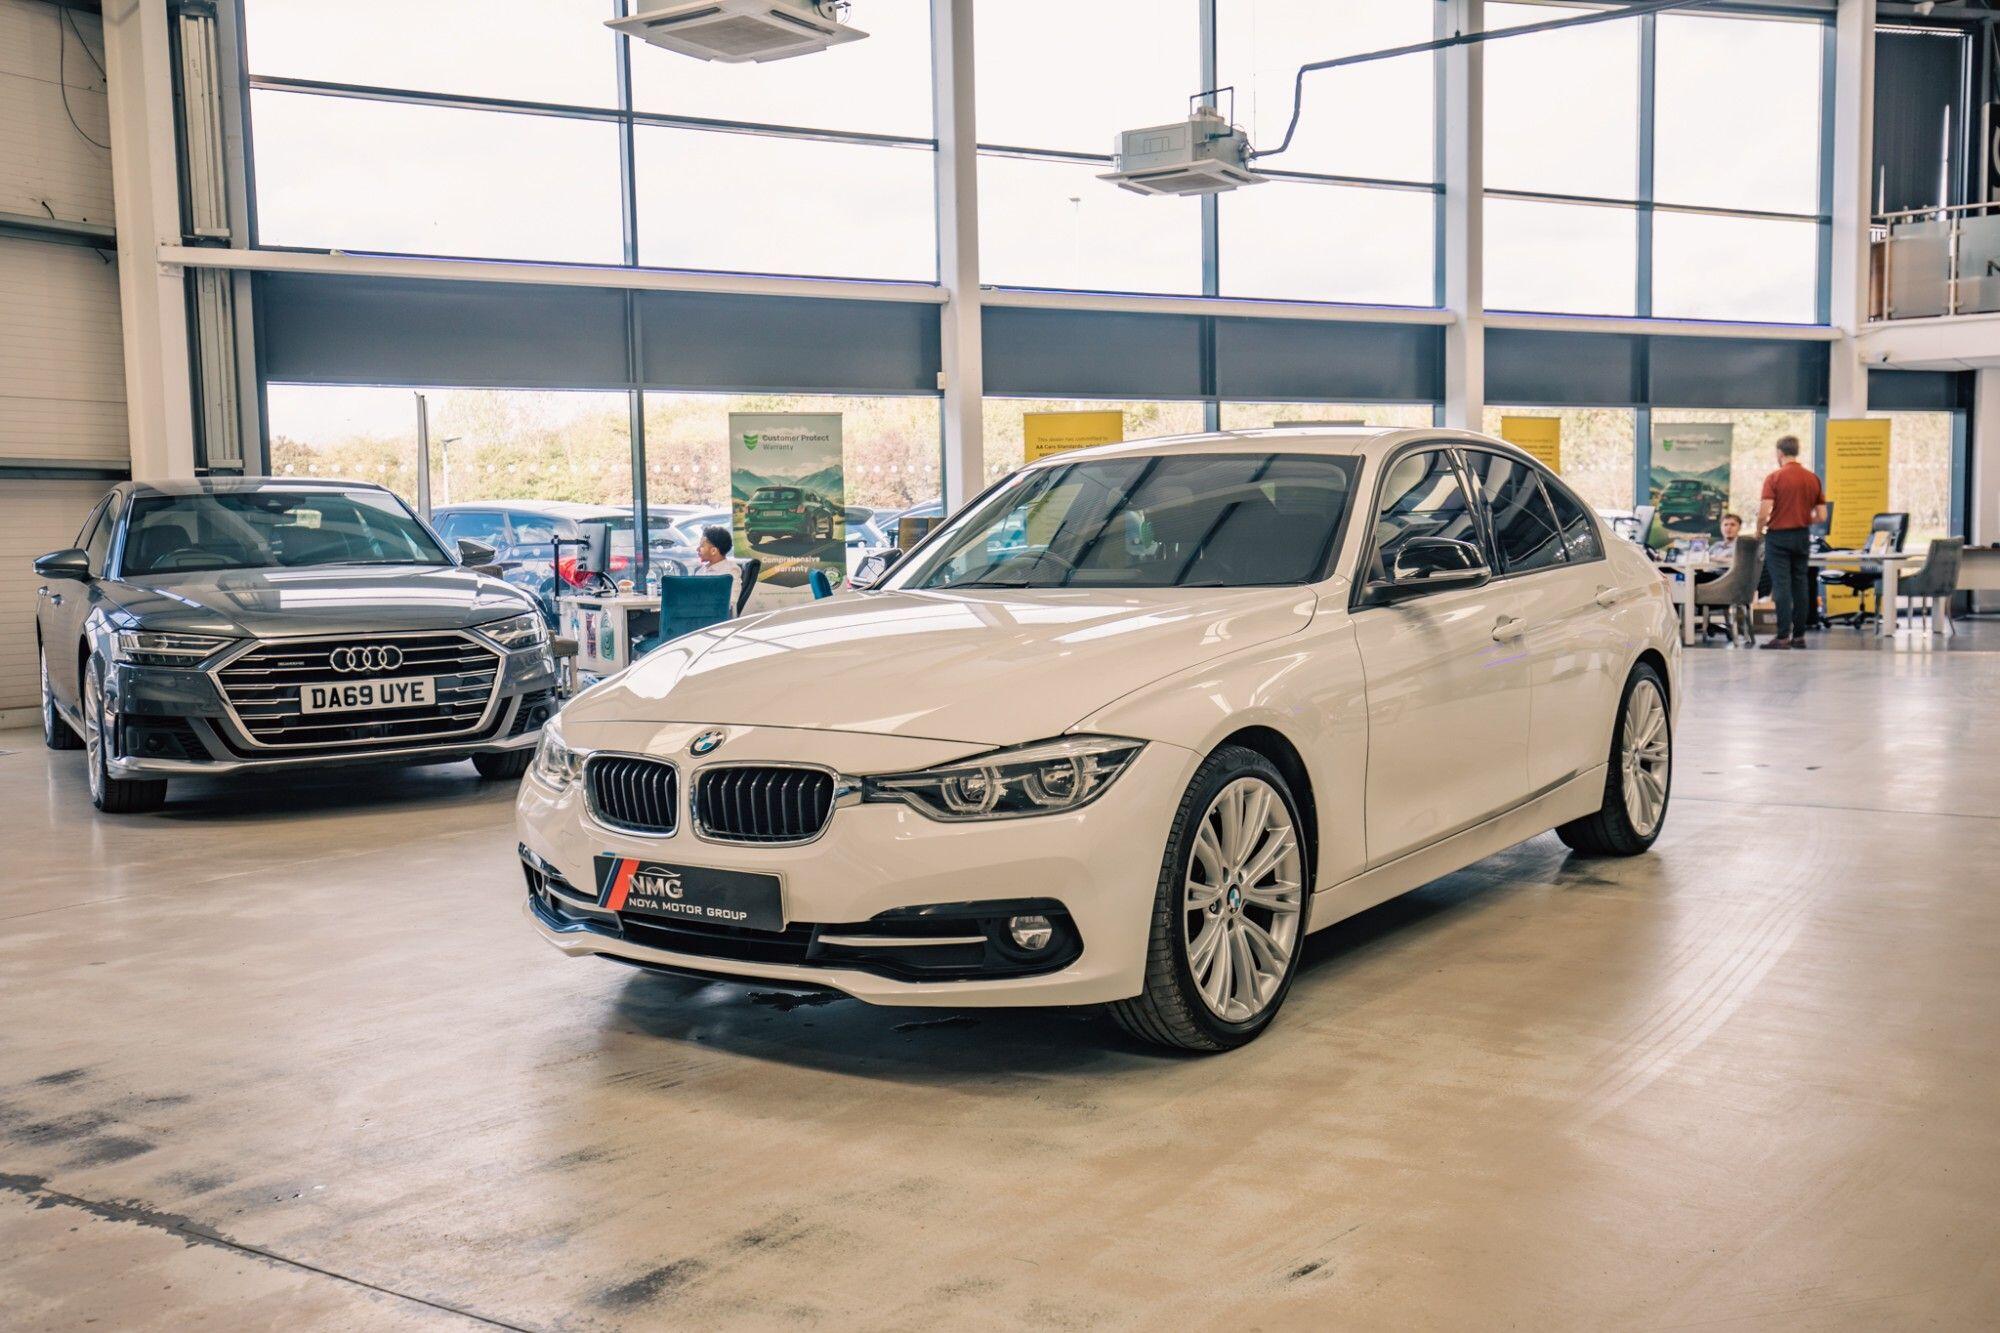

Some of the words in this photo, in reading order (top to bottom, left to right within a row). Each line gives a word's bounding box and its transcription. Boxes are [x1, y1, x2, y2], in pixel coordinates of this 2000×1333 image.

[762, 434, 799, 442] Customer
[801, 434, 829, 442] Protect
[761, 556, 820, 564] Comprehensive
[312, 685, 373, 709] DA69
[380, 682, 425, 704] UYE
[628, 874, 683, 898] NMG
[629, 898, 659, 910] NOYA
[662, 902, 702, 915] MOTOR
[706, 907, 747, 921] GROUP
